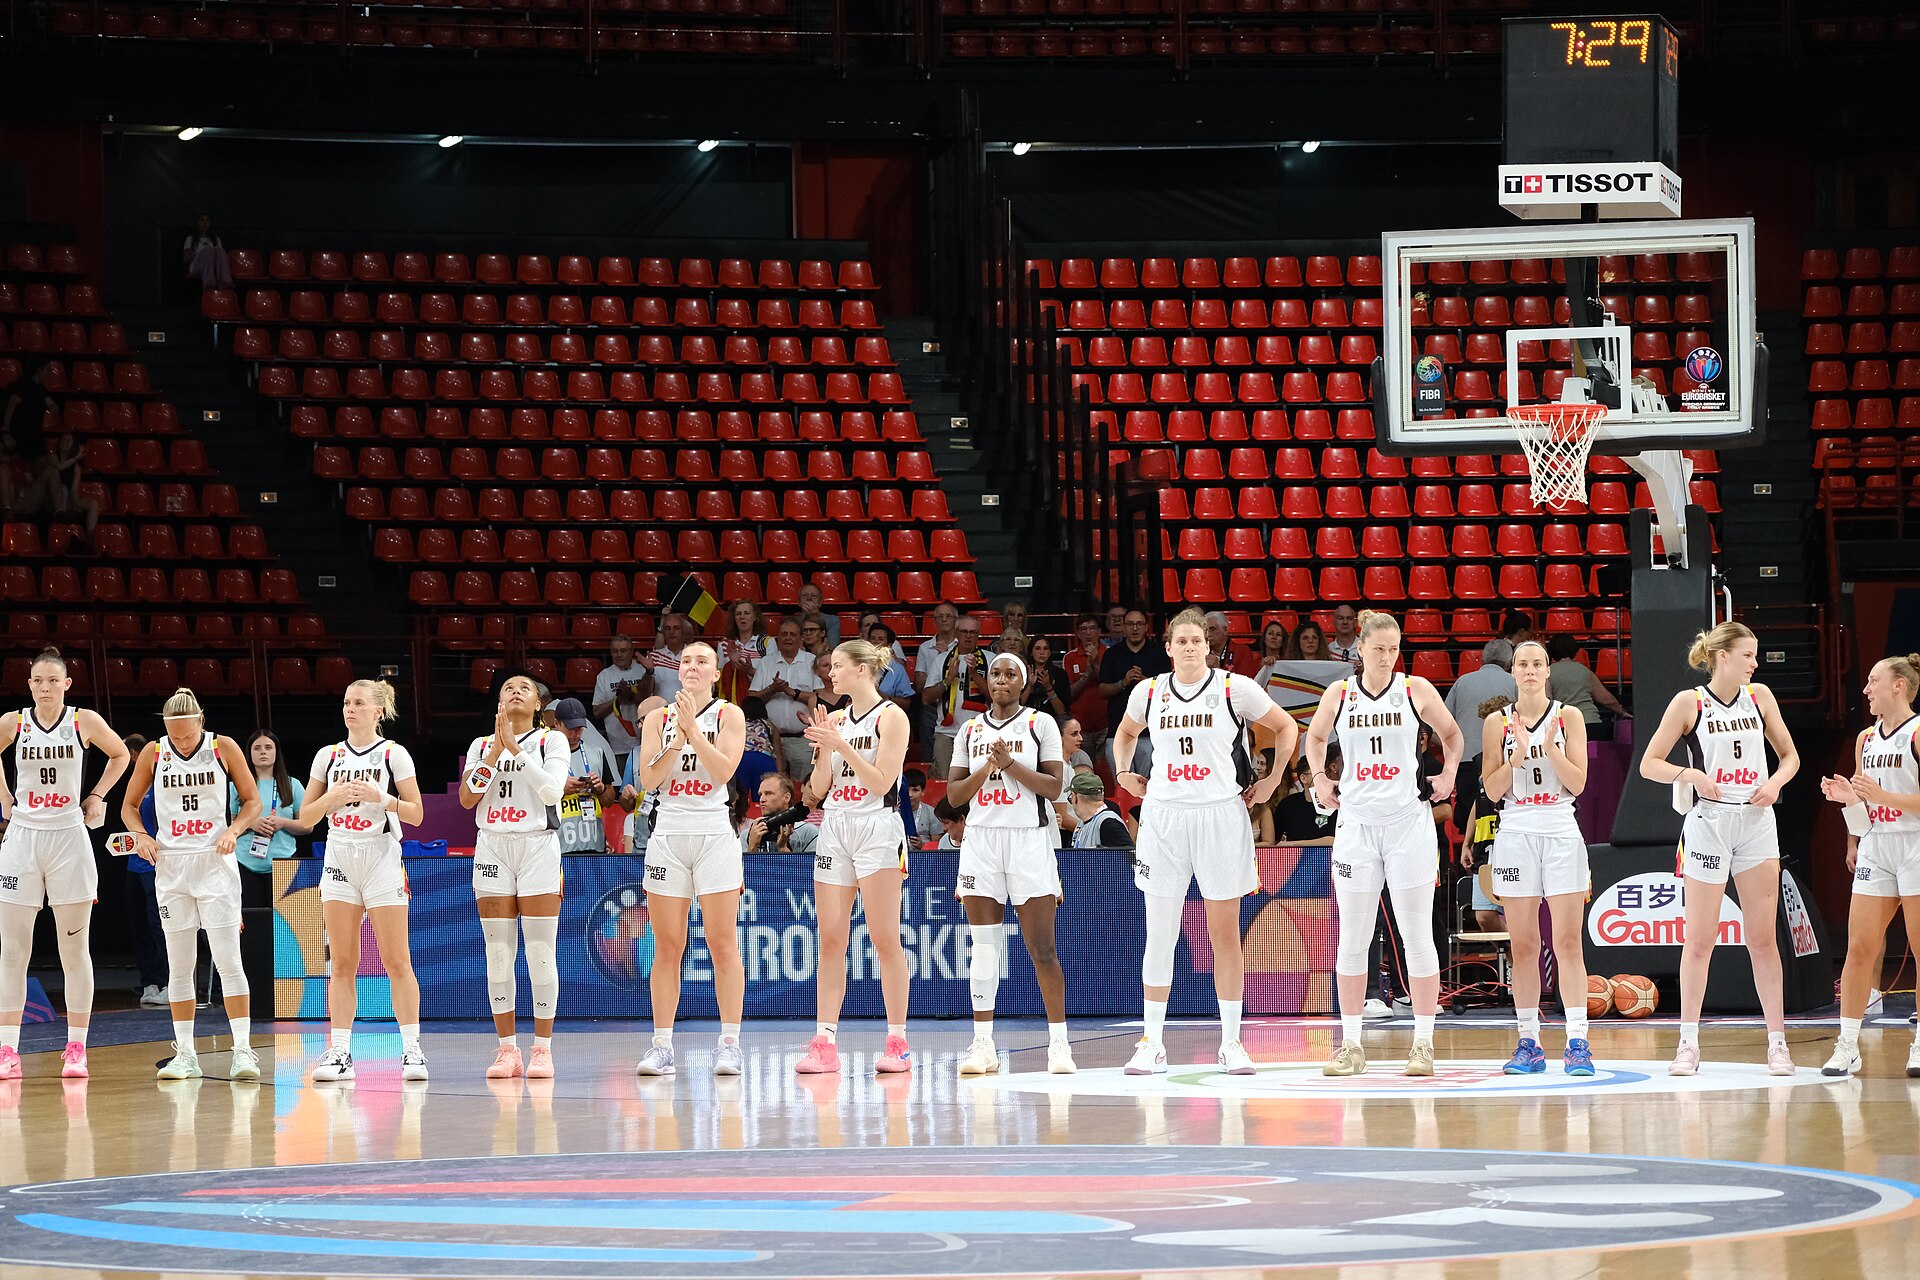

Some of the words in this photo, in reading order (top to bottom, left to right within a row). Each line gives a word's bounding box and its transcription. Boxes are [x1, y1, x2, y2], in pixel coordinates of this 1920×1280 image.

[1551, 21, 1650, 67] 7:29
[1546, 173, 1653, 193] TISSOT
[1420, 389, 1440, 400] FIBA
[1681, 392, 1726, 401] EUROBASKET
[1160, 714, 1213, 729] BELGIUM
[1349, 713, 1402, 729] BELGIUM
[1708, 717, 1759, 735] BELGIUM
[22, 745, 74, 760] BELGIUM
[1178, 736, 1194, 755] 13
[1369, 735, 1383, 755] 11
[1733, 740, 1742, 759] 5
[681, 754, 697, 772] 27
[40, 767, 57, 785] 99
[162, 771, 216, 788] BELGIUM
[1532, 767, 1543, 785] 6
[499, 780, 513, 799] 31
[181, 794, 199, 812] 55
[816, 862, 833, 870] ADE
[1691, 851, 1721, 864] POWER
[1703, 861, 1721, 870] ADE
[482, 870, 499, 879] ADE
[650, 872, 667, 881] ADE
[1493, 867, 1520, 875] POWER
[1502, 874, 1521, 882] ADE
[2, 881, 18, 891] ADE
[1616, 883, 1686, 909] 百岁
[1597, 908, 1742, 945] Gantn
